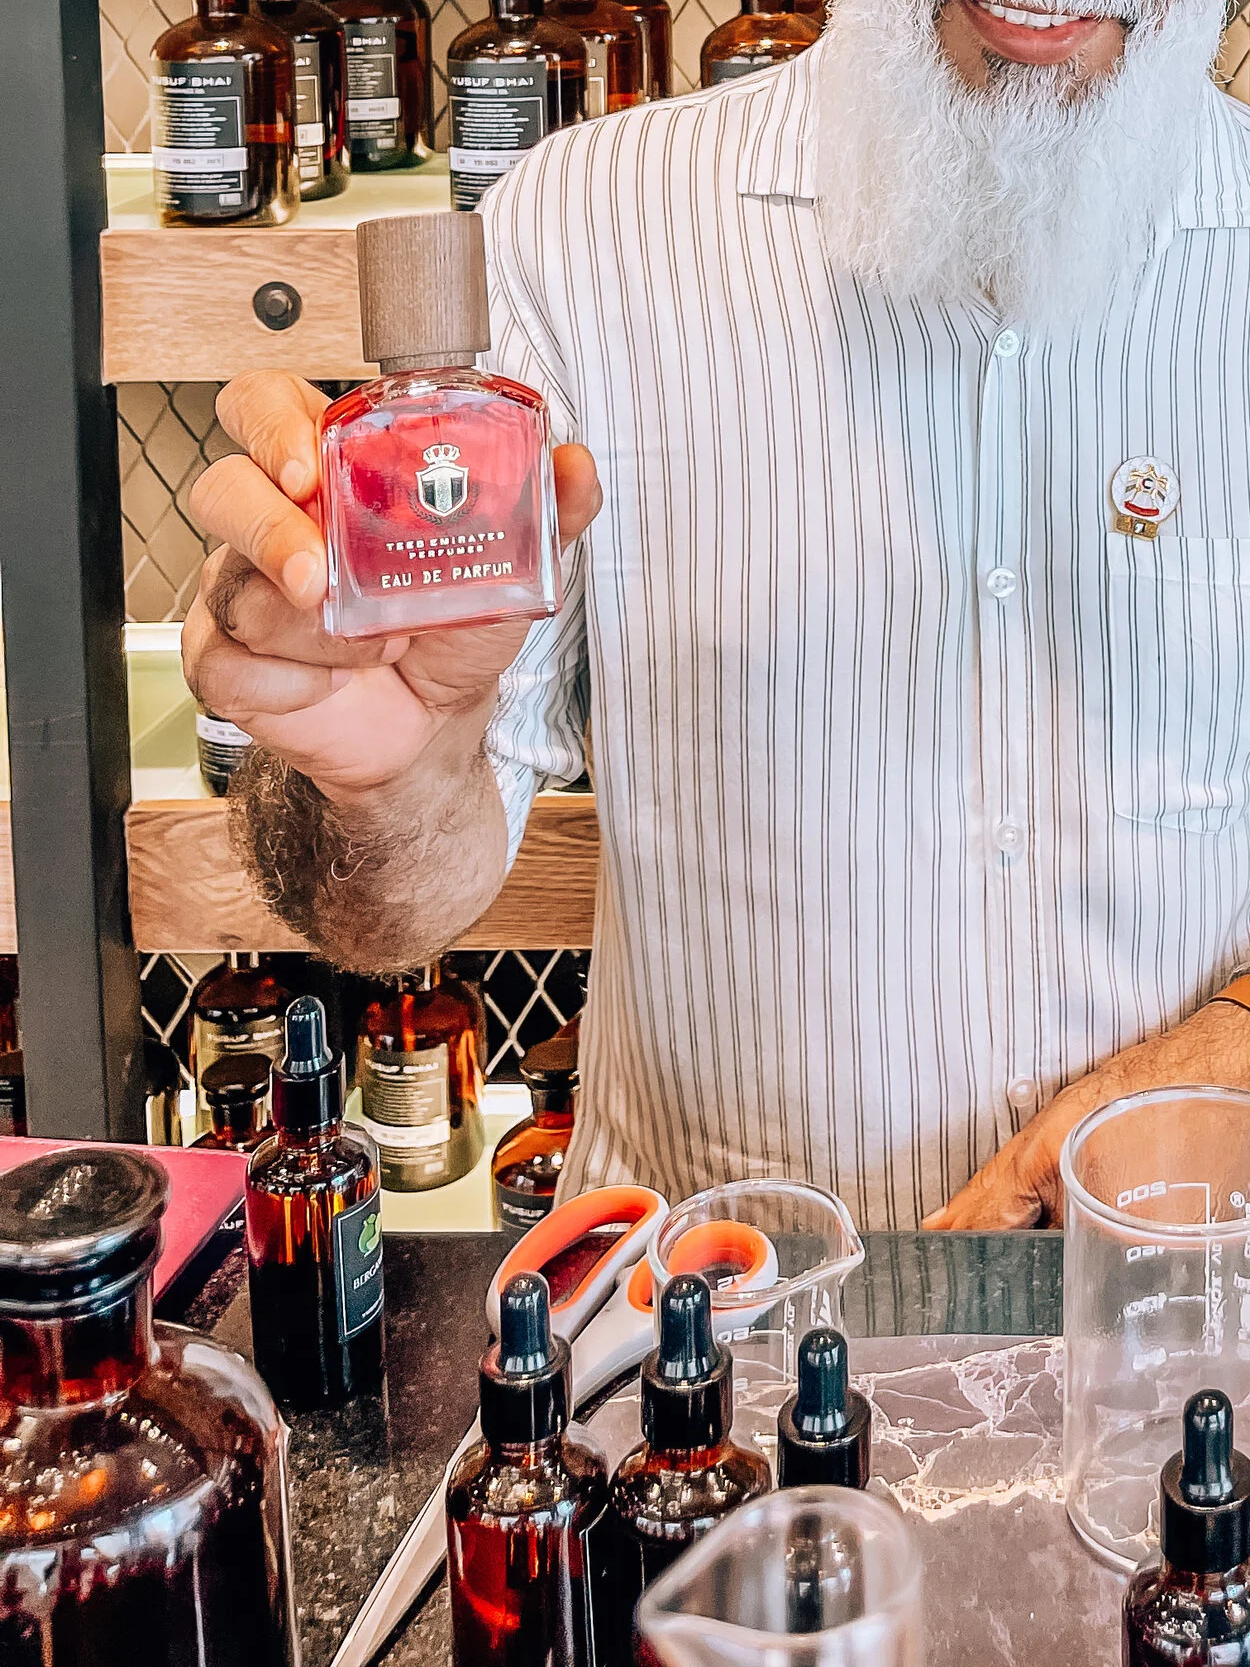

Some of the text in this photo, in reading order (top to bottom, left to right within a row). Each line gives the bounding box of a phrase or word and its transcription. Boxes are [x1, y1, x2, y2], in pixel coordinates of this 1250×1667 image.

[352, 36, 387, 46] BHAI
[192, 76, 232, 87] BHAI
[452, 76, 534, 88] YUSUF BHAI
[430, 532, 505, 547] EMIRATES
[408, 544, 484, 560] PERFUMES
[381, 573, 412, 589] EAU
[422, 569, 442, 584] DE
